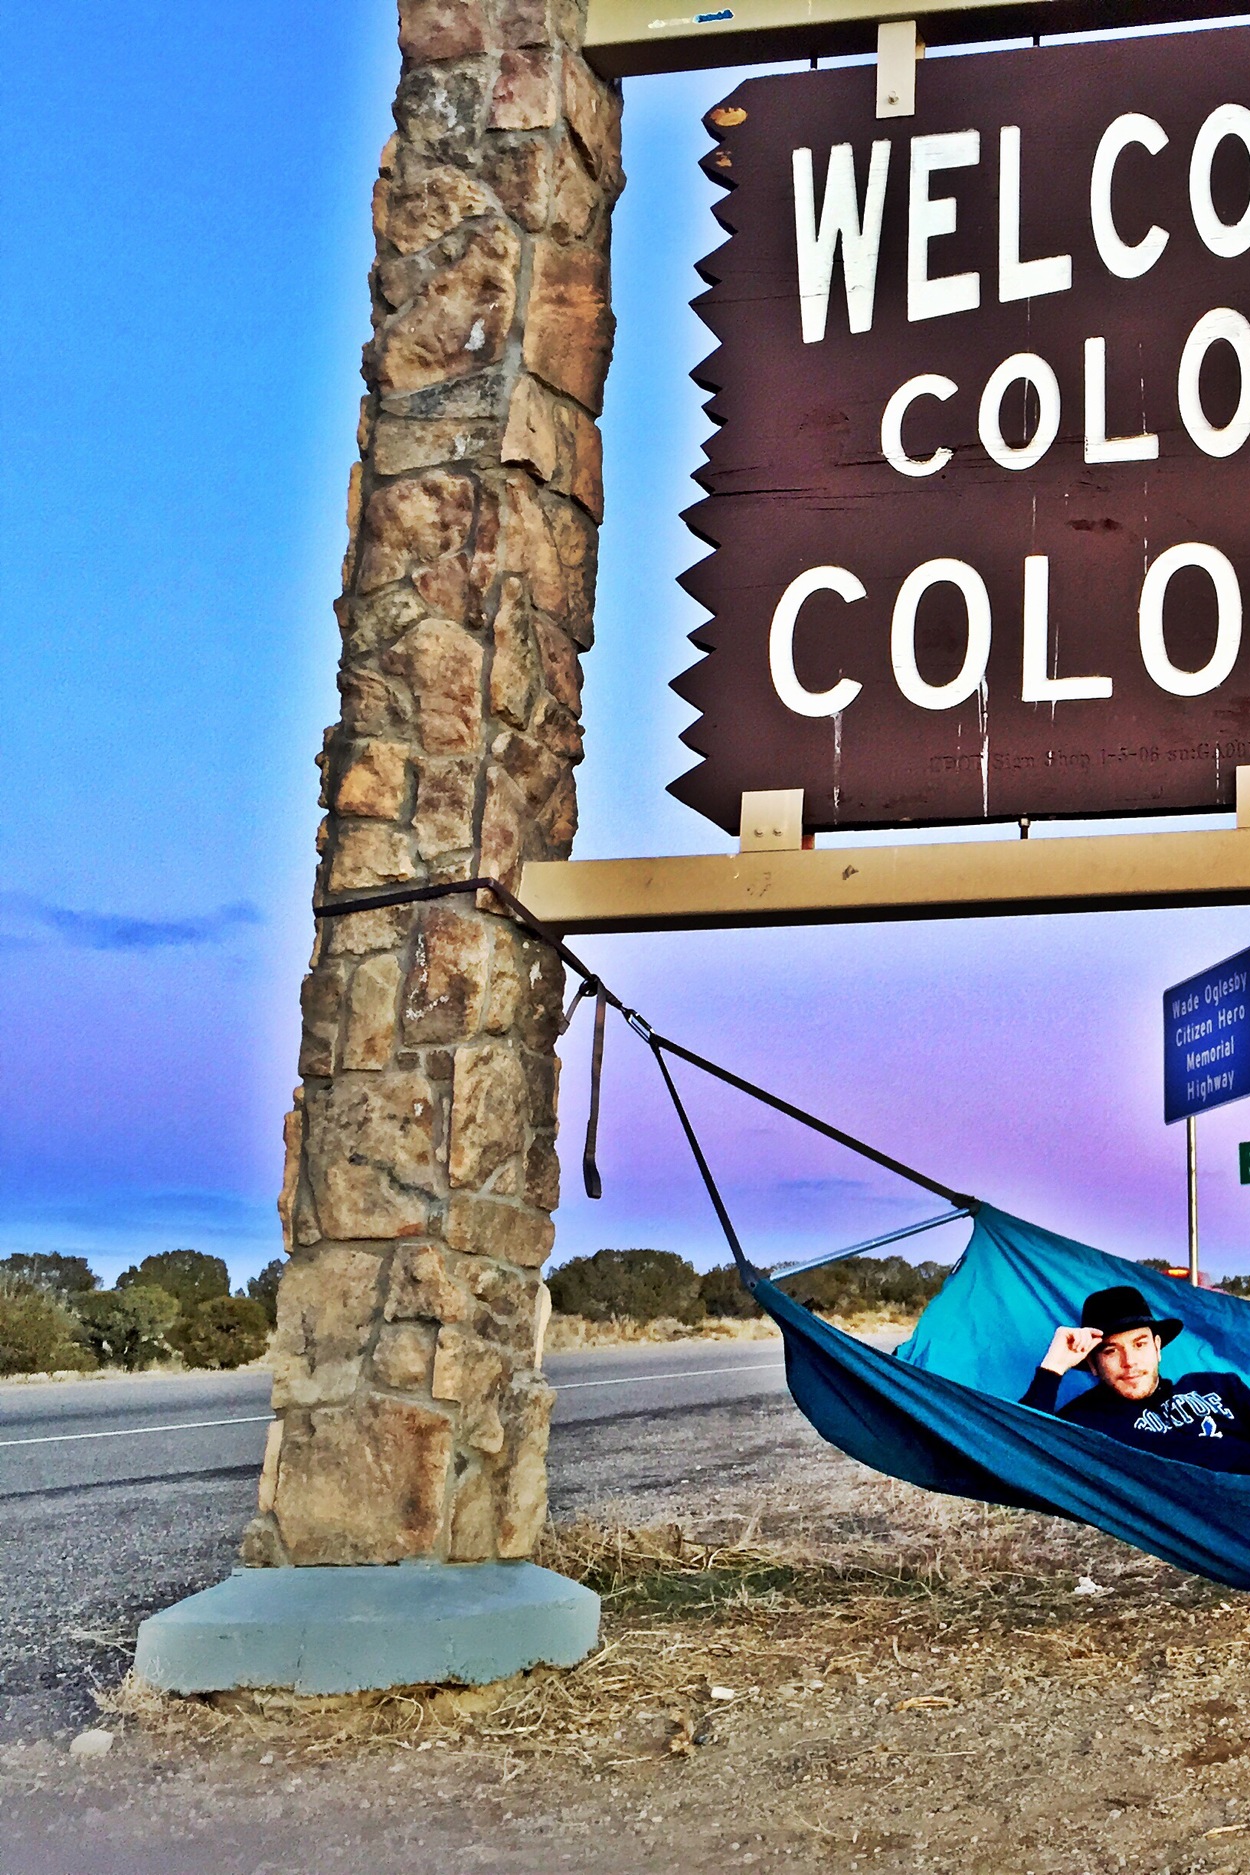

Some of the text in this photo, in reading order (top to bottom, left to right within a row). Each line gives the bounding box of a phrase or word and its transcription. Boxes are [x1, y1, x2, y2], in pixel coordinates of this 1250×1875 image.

[1172, 971, 1248, 1020] Wade Oglesby
[1176, 1004, 1246, 1047] Citizen Hero
[1186, 1035, 1235, 1072] Memorial
[1187, 1070, 1235, 1102] Highway
